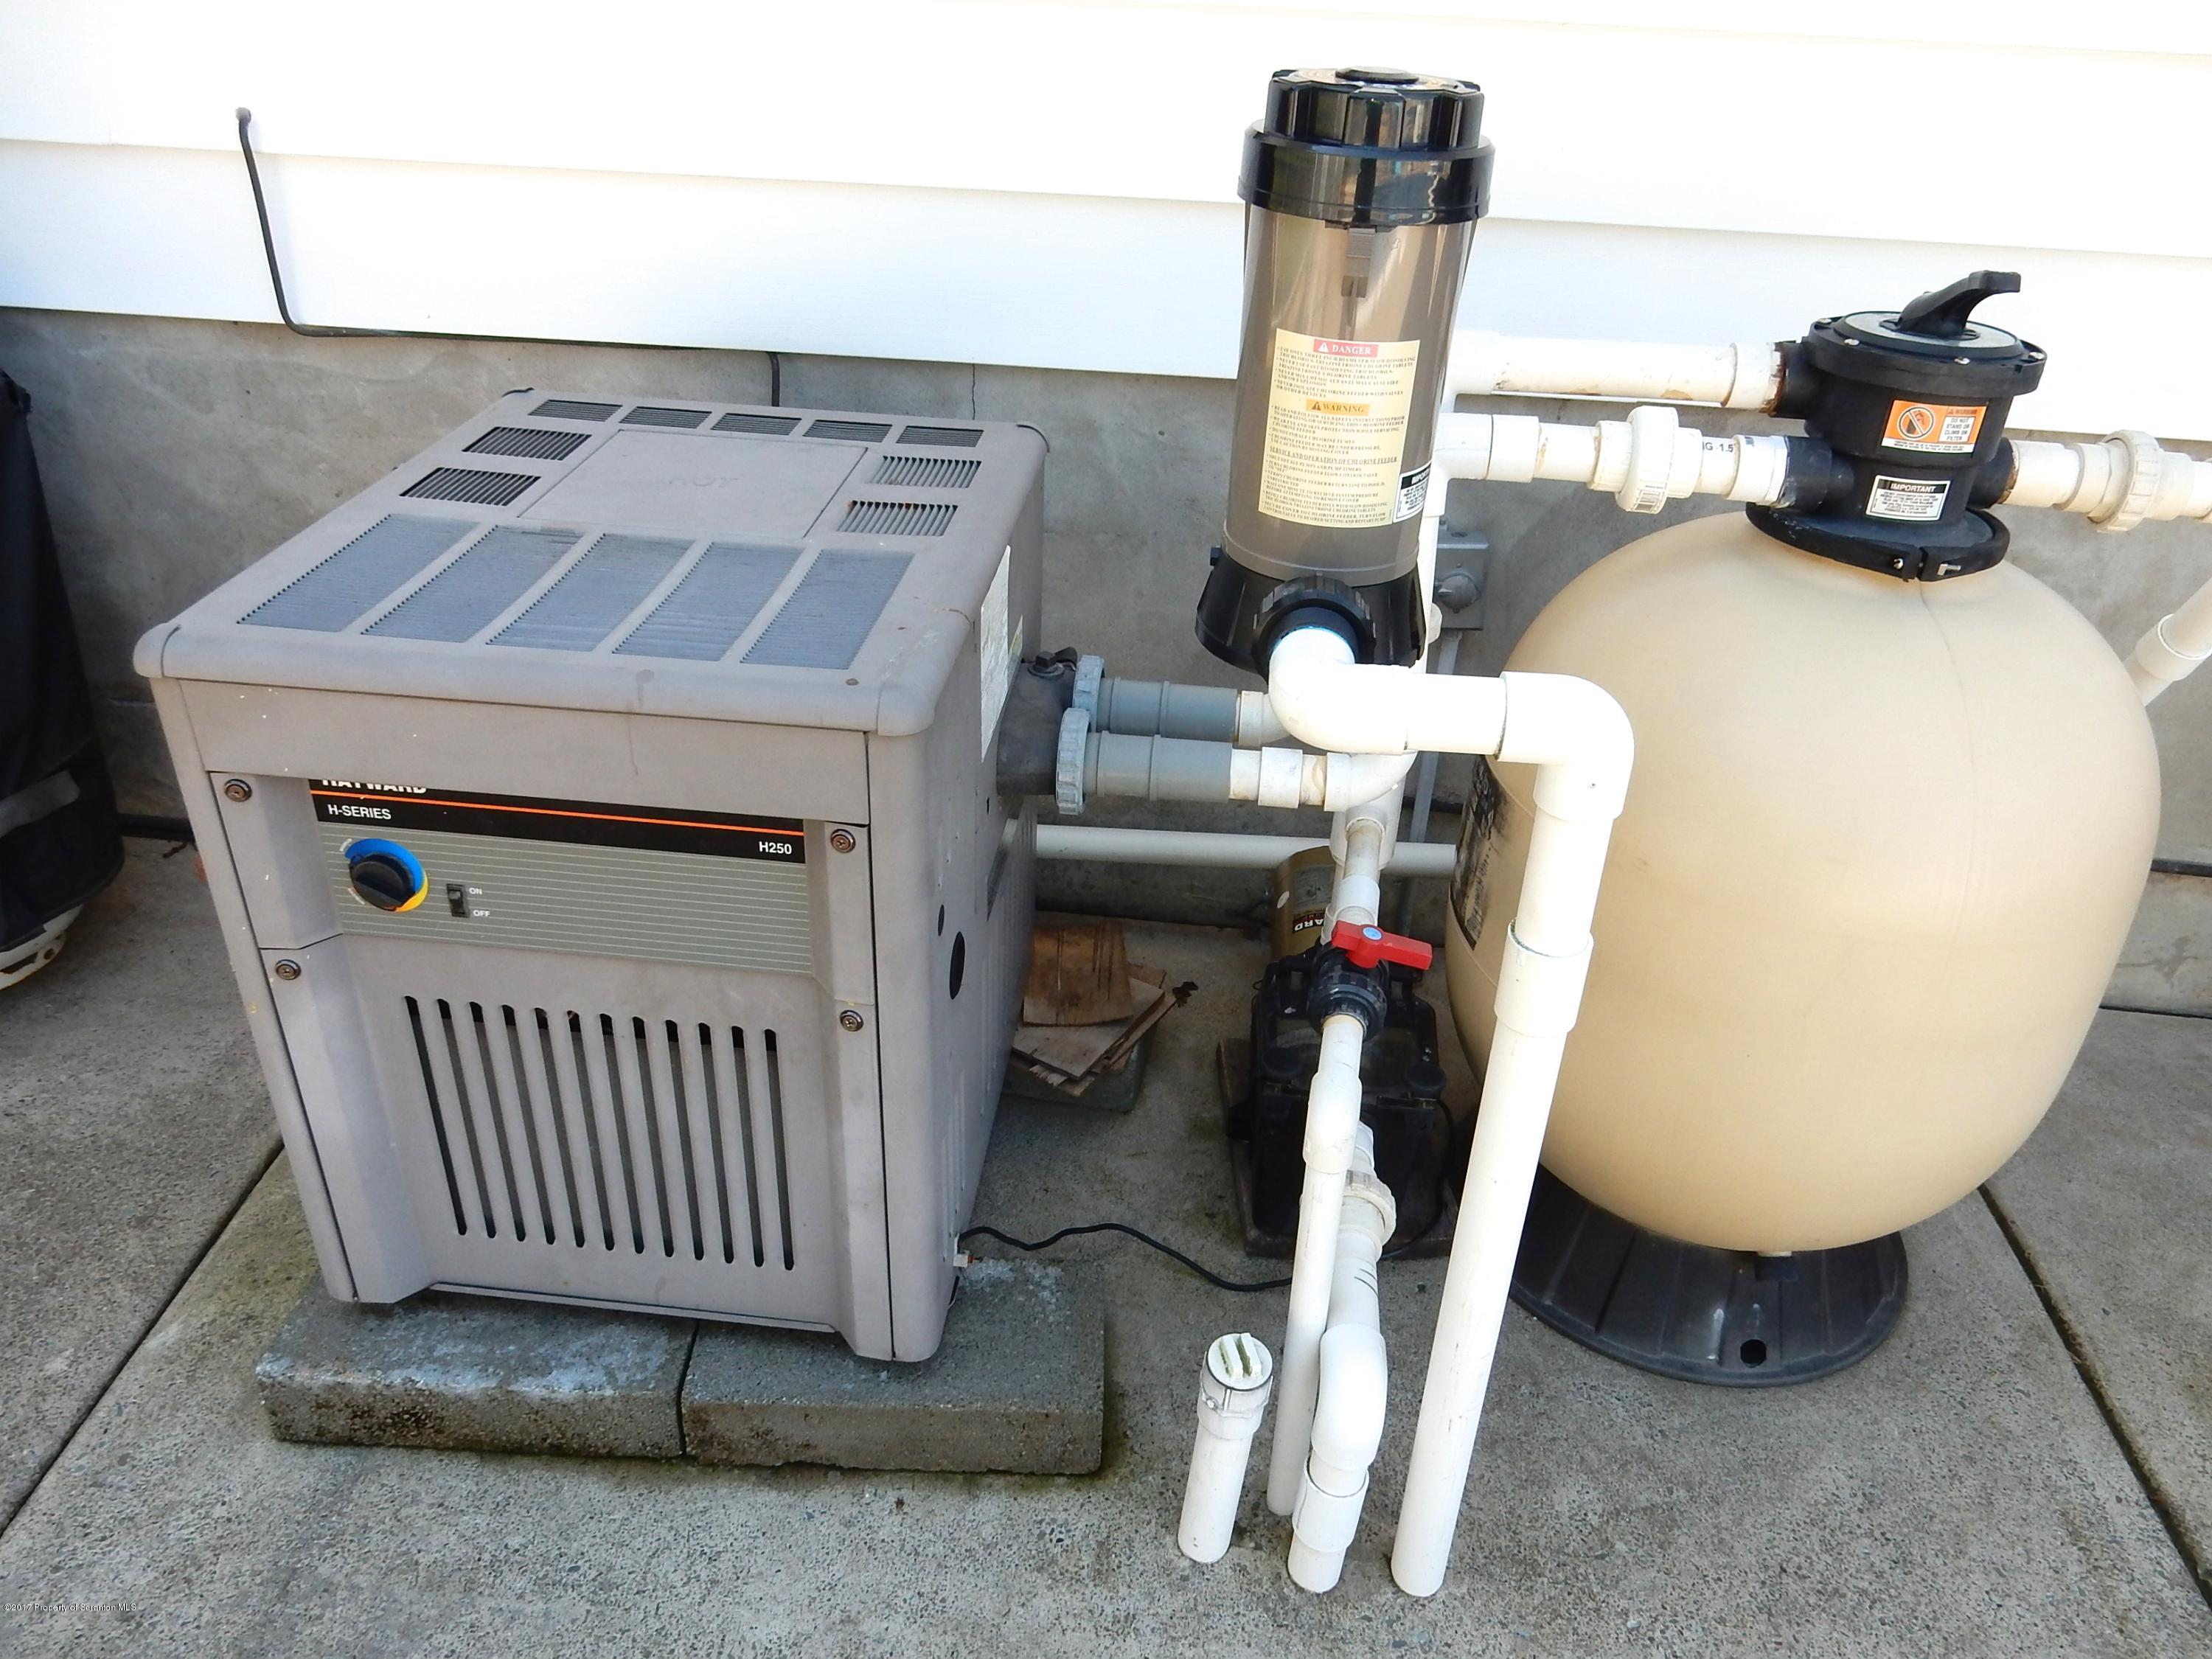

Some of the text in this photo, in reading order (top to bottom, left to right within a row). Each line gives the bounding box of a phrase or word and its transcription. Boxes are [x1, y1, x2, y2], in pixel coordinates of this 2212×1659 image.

[1332, 344, 1371, 355] DANGER
[1324, 403, 1363, 413] WARNING
[1891, 483, 1936, 493] IMPORTANT
[327, 804, 392, 820] H-SERIES
[759, 841, 793, 855] H250
[469, 887, 483, 895] ON
[473, 909, 490, 917] OFF
